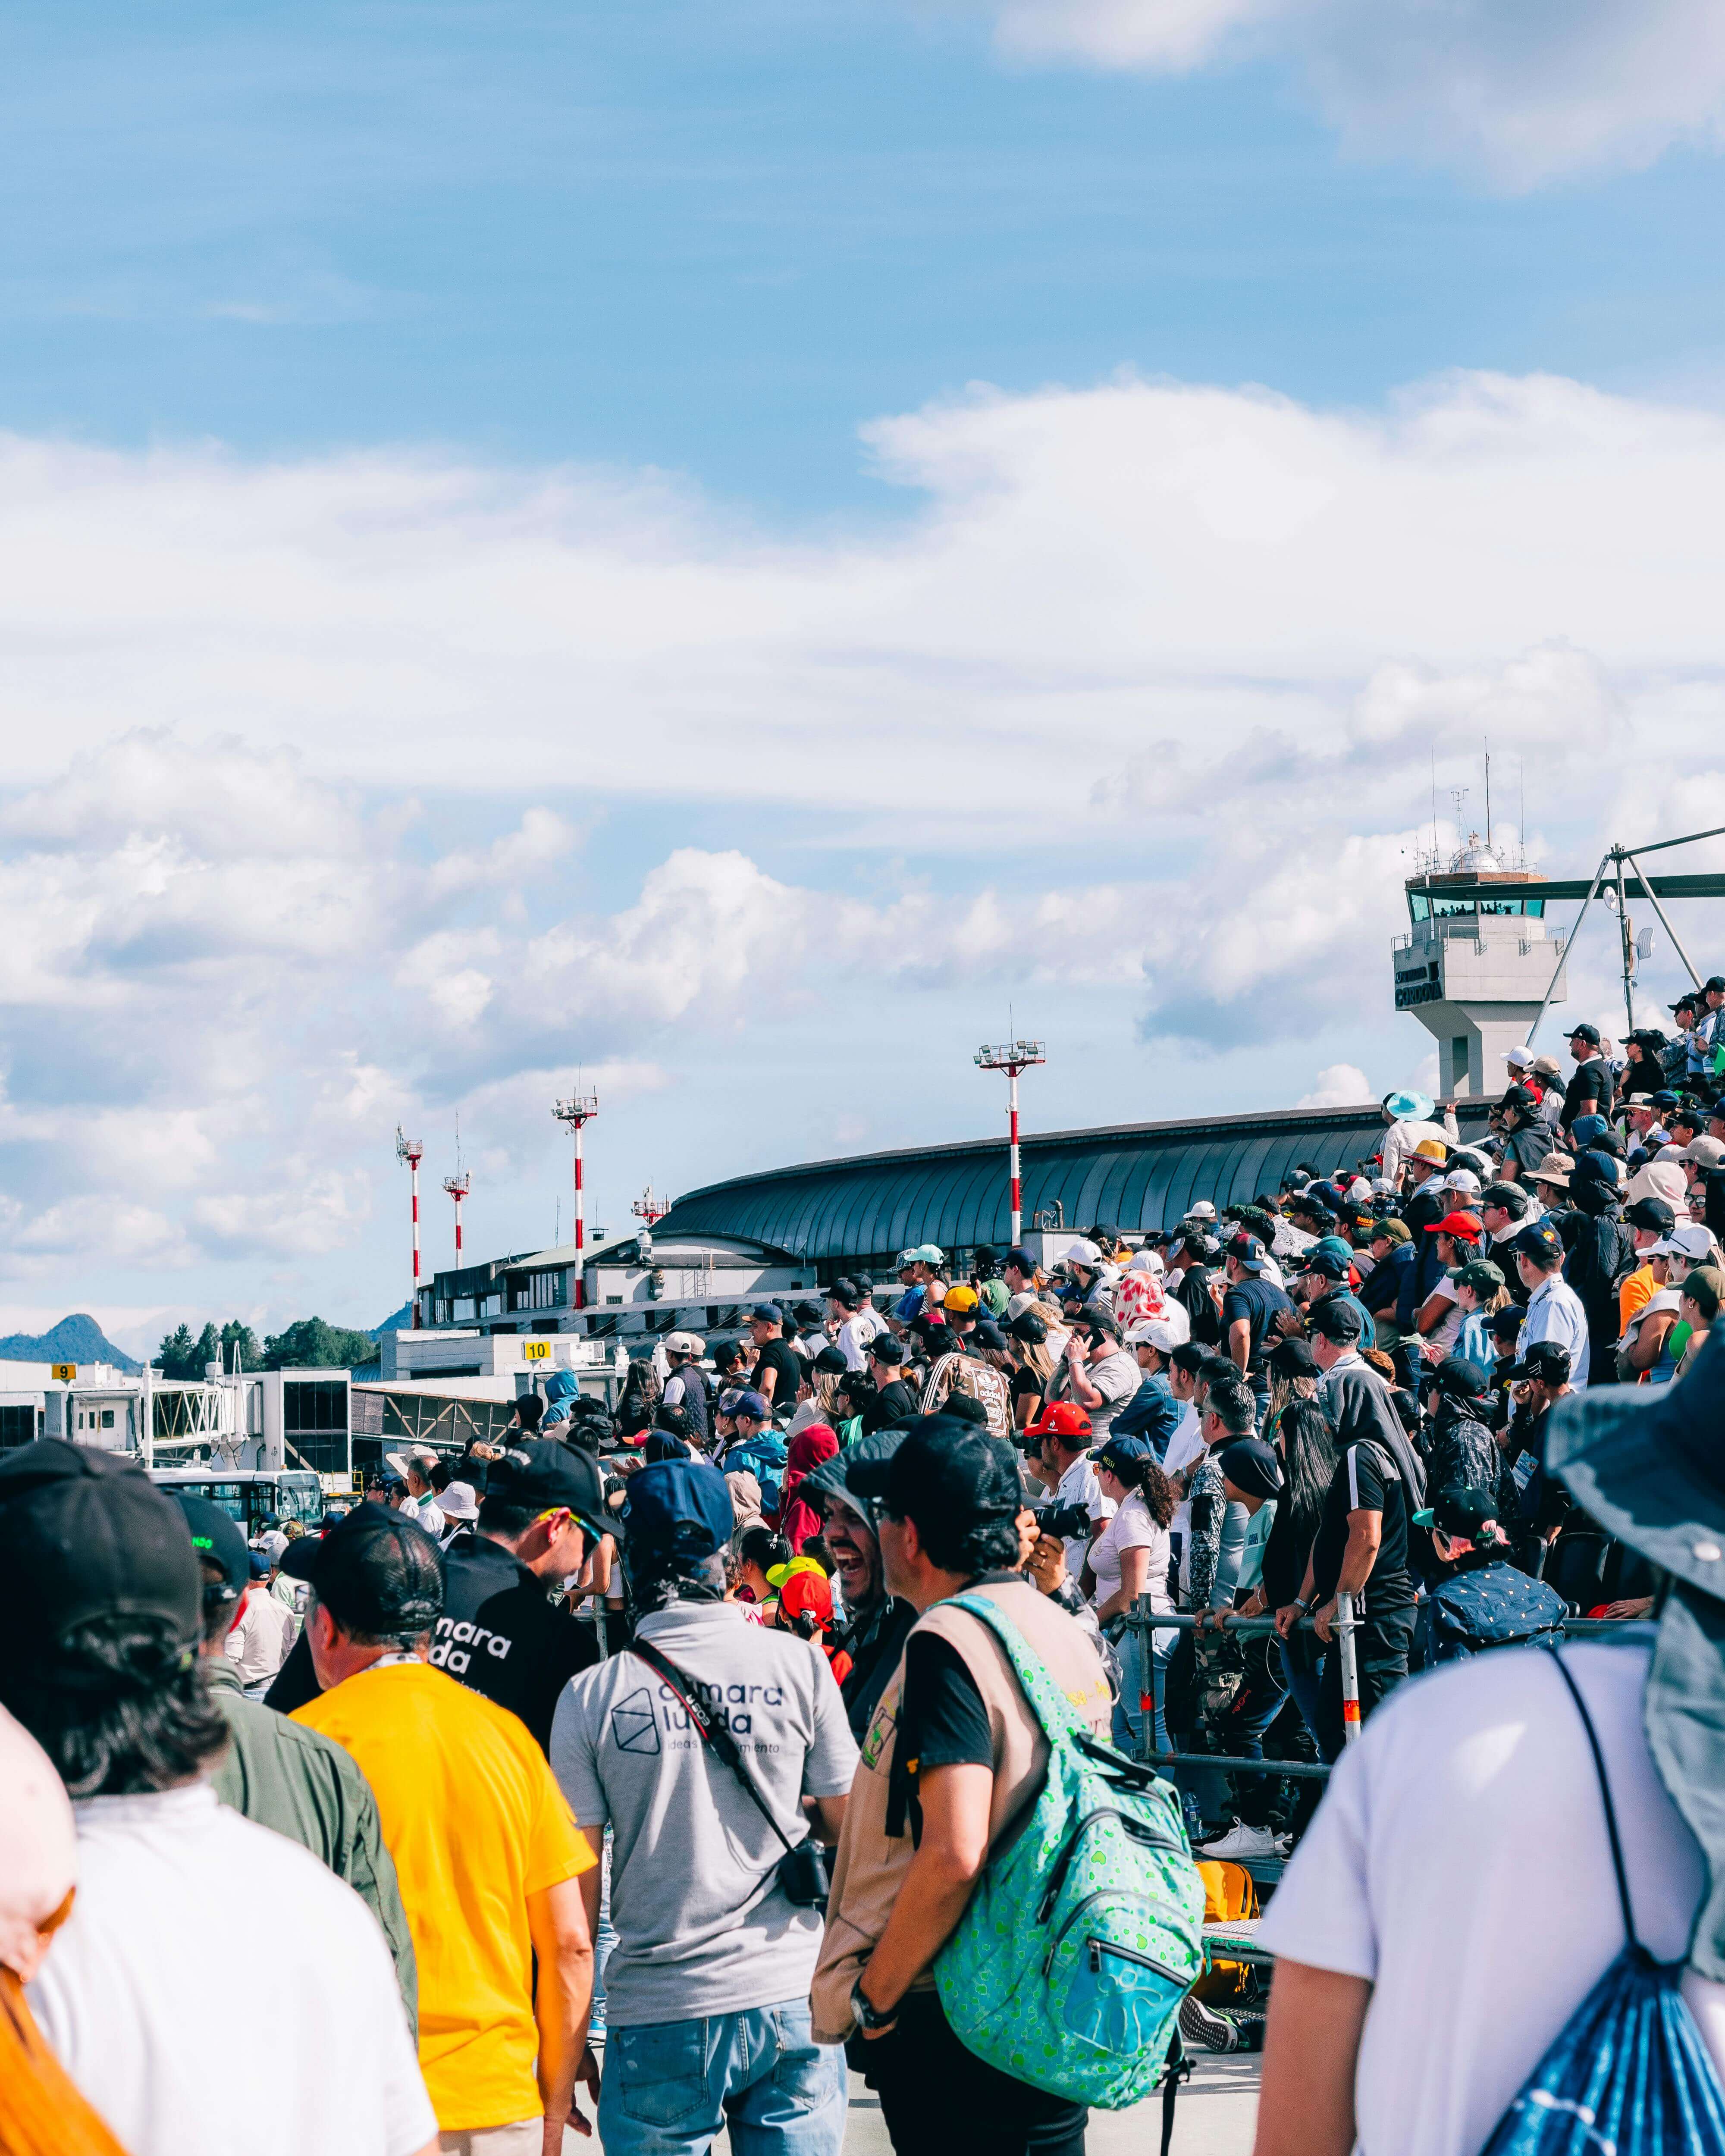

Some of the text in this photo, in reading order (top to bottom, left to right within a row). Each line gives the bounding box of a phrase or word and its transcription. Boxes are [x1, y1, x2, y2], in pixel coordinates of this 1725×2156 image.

[1395, 982, 1443, 1006] CORDOVA
[530, 1344, 545, 1357] 10
[60, 1366, 68, 1378] 9
[1103, 1455, 1115, 1468] MESSI
[668, 1739, 698, 1749] ideas
